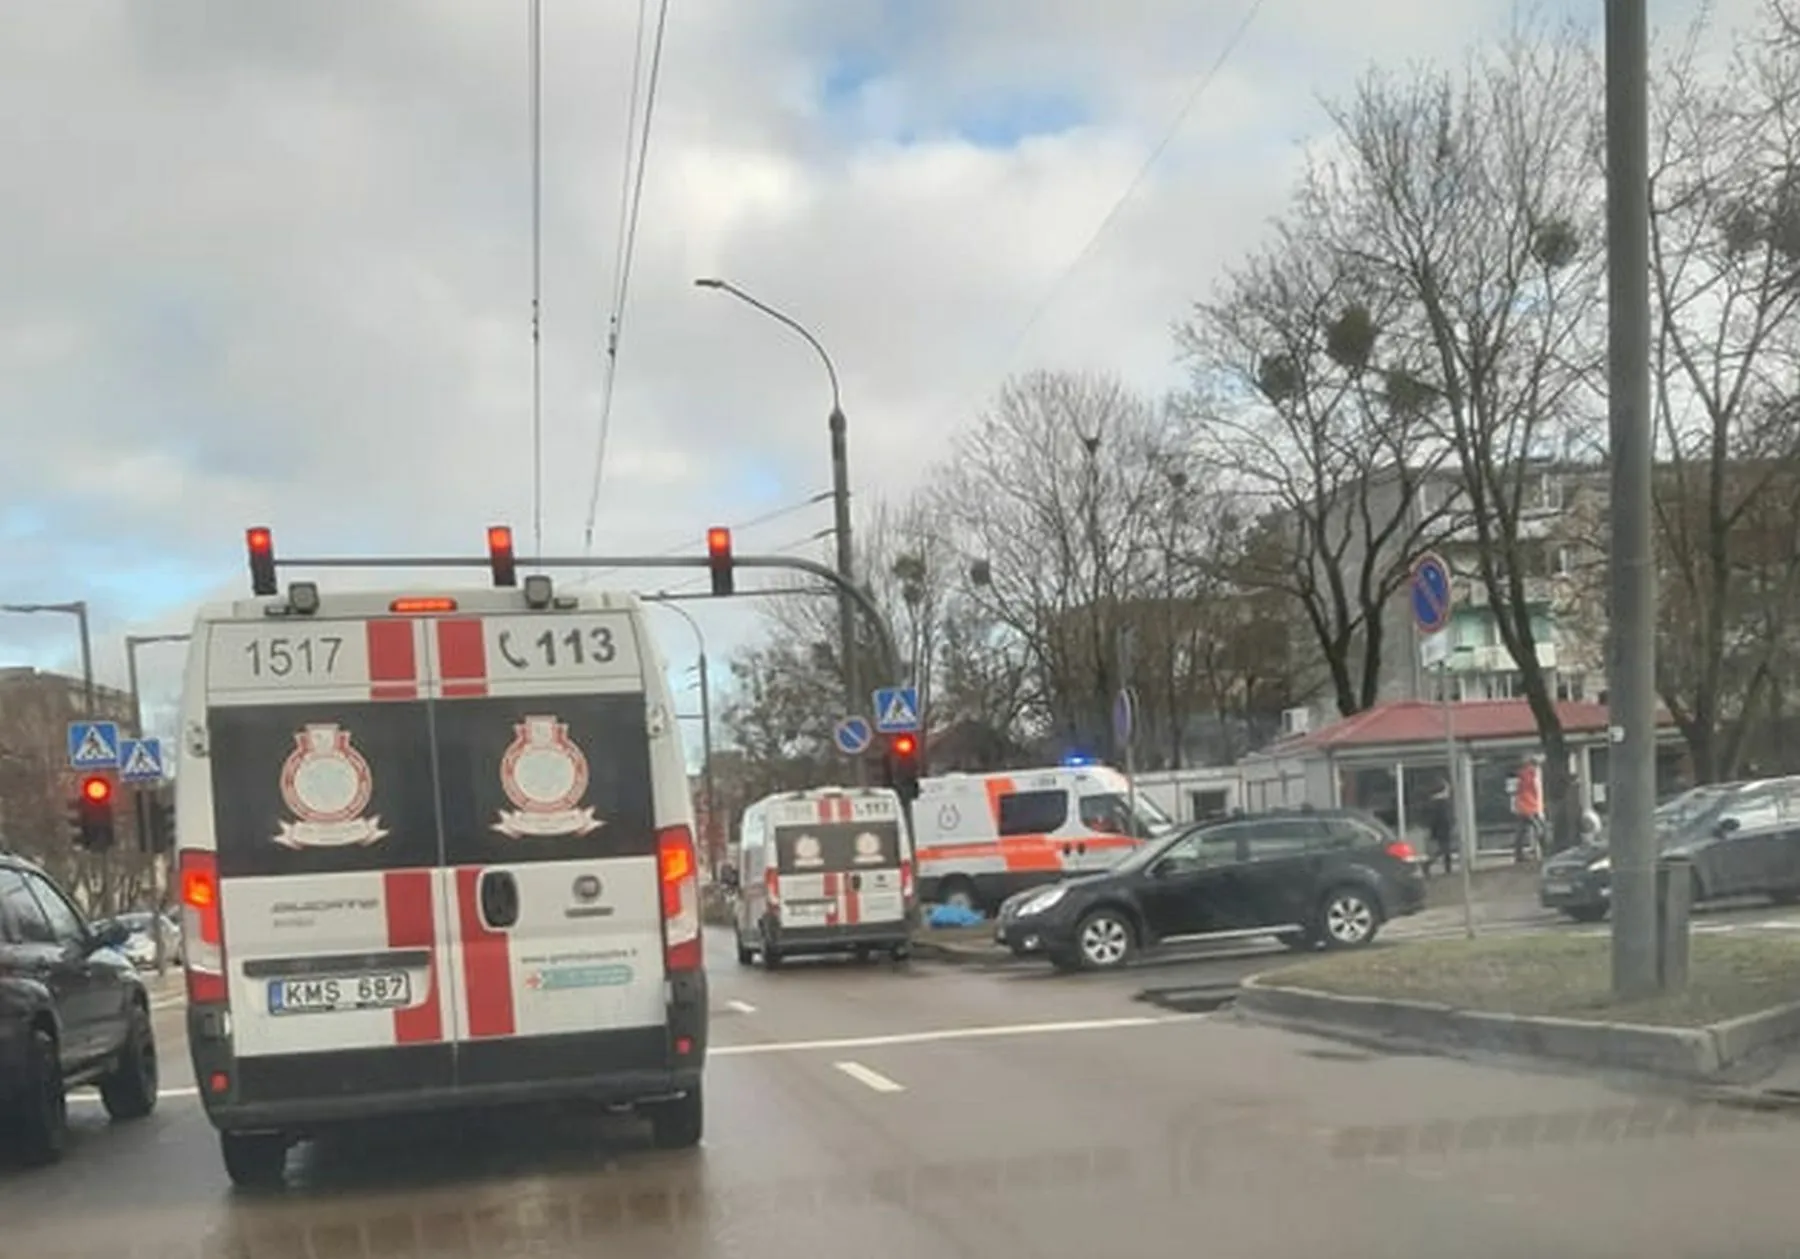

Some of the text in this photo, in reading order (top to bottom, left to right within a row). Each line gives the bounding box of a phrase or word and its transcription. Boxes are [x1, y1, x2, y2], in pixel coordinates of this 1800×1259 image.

[246, 637, 343, 676] 1517
[536, 626, 616, 667] 113
[286, 977, 403, 1005] KMS 687
